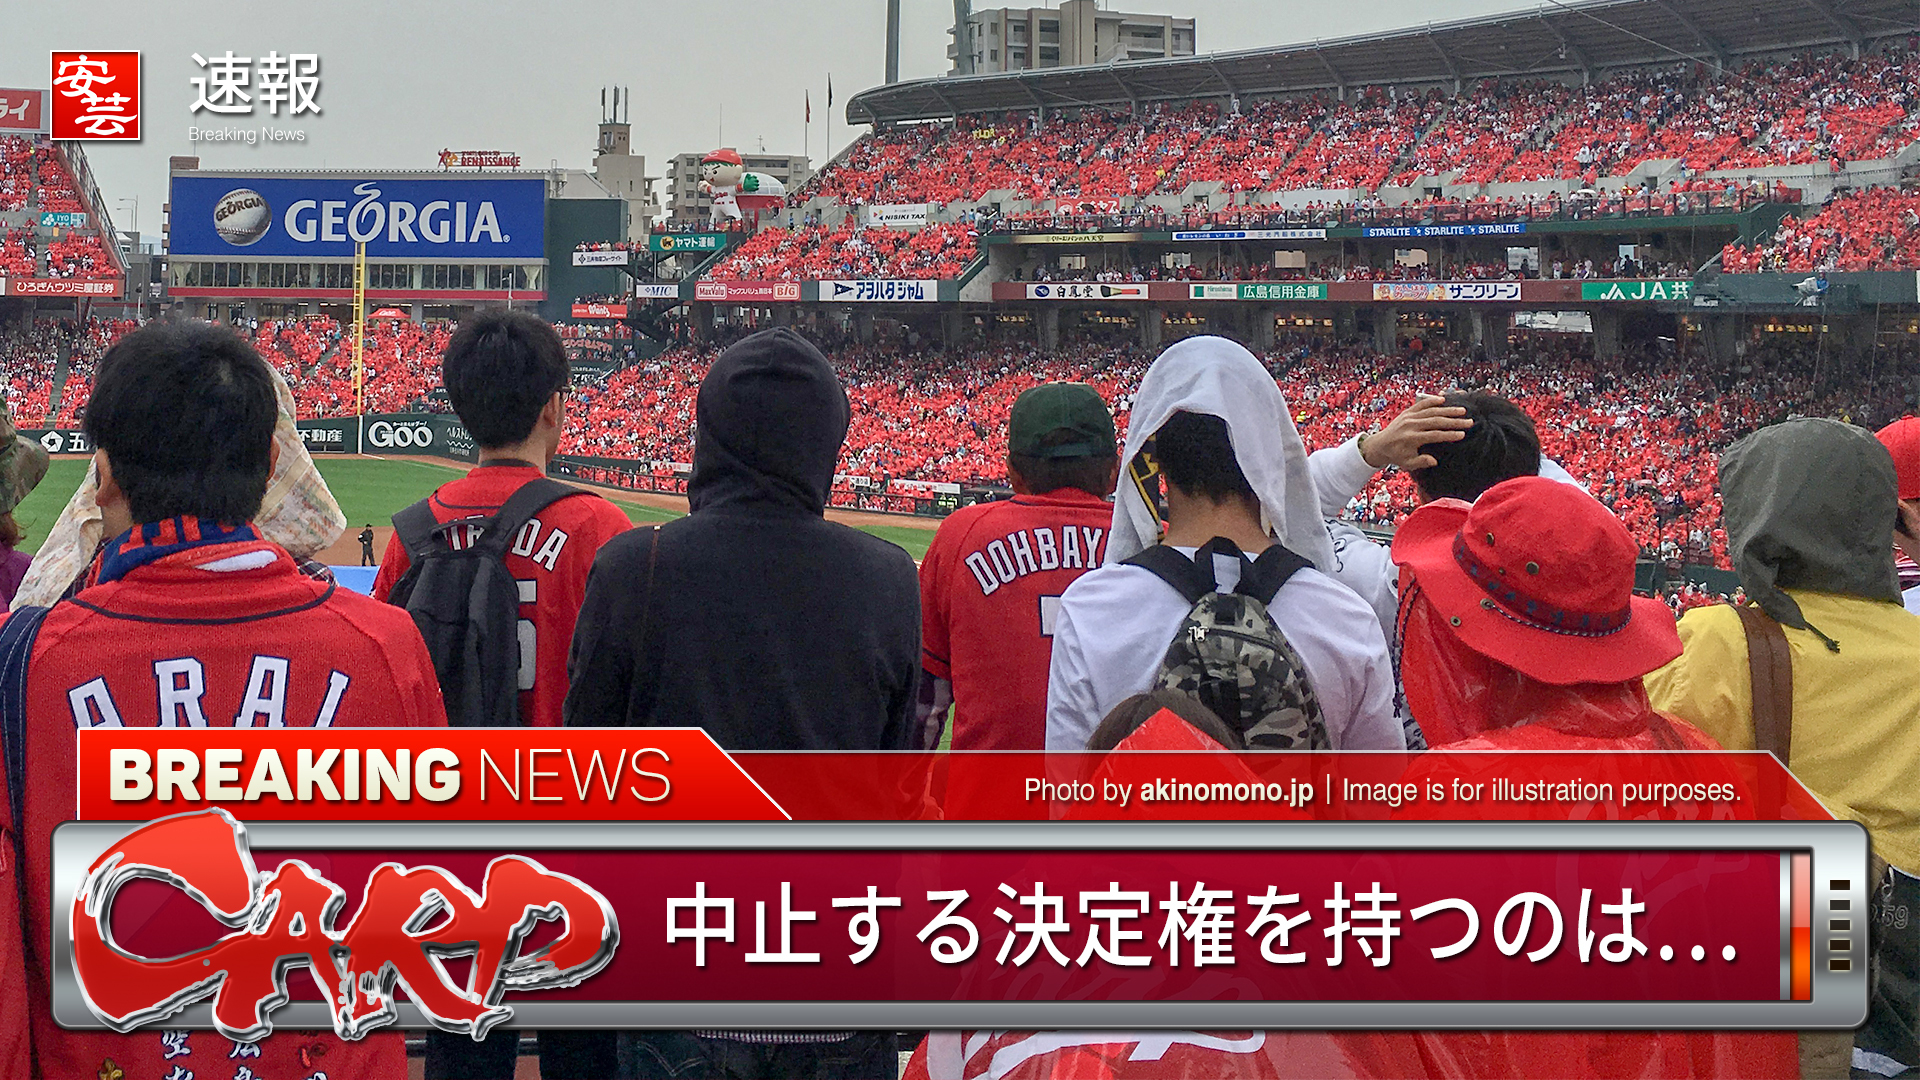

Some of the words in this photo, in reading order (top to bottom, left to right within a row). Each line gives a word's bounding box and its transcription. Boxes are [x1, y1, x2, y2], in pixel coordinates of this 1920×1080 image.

[461, 156, 521, 167] RENAISSANCE
[215, 197, 264, 222] GEORGIA
[284, 181, 504, 243] GEORGIA
[1369, 227, 1411, 237] STARLITE
[1424, 226, 1464, 236] STARLITE
[1478, 224, 1520, 234] STARLITE
[676, 234, 716, 248] ヤマト運輸
[17, 282, 115, 294] ひろぎんウツミ屋証券
[650, 286, 672, 296] MIC
[699, 283, 725, 296] MaxValu
[1243, 284, 1320, 299] 広島信用金庫
[1450, 284, 1519, 299] サニクリーン
[588, 304, 610, 318] Wants
[965, 525, 1110, 595] DOHBAY
[68, 654, 350, 728] ARAI
